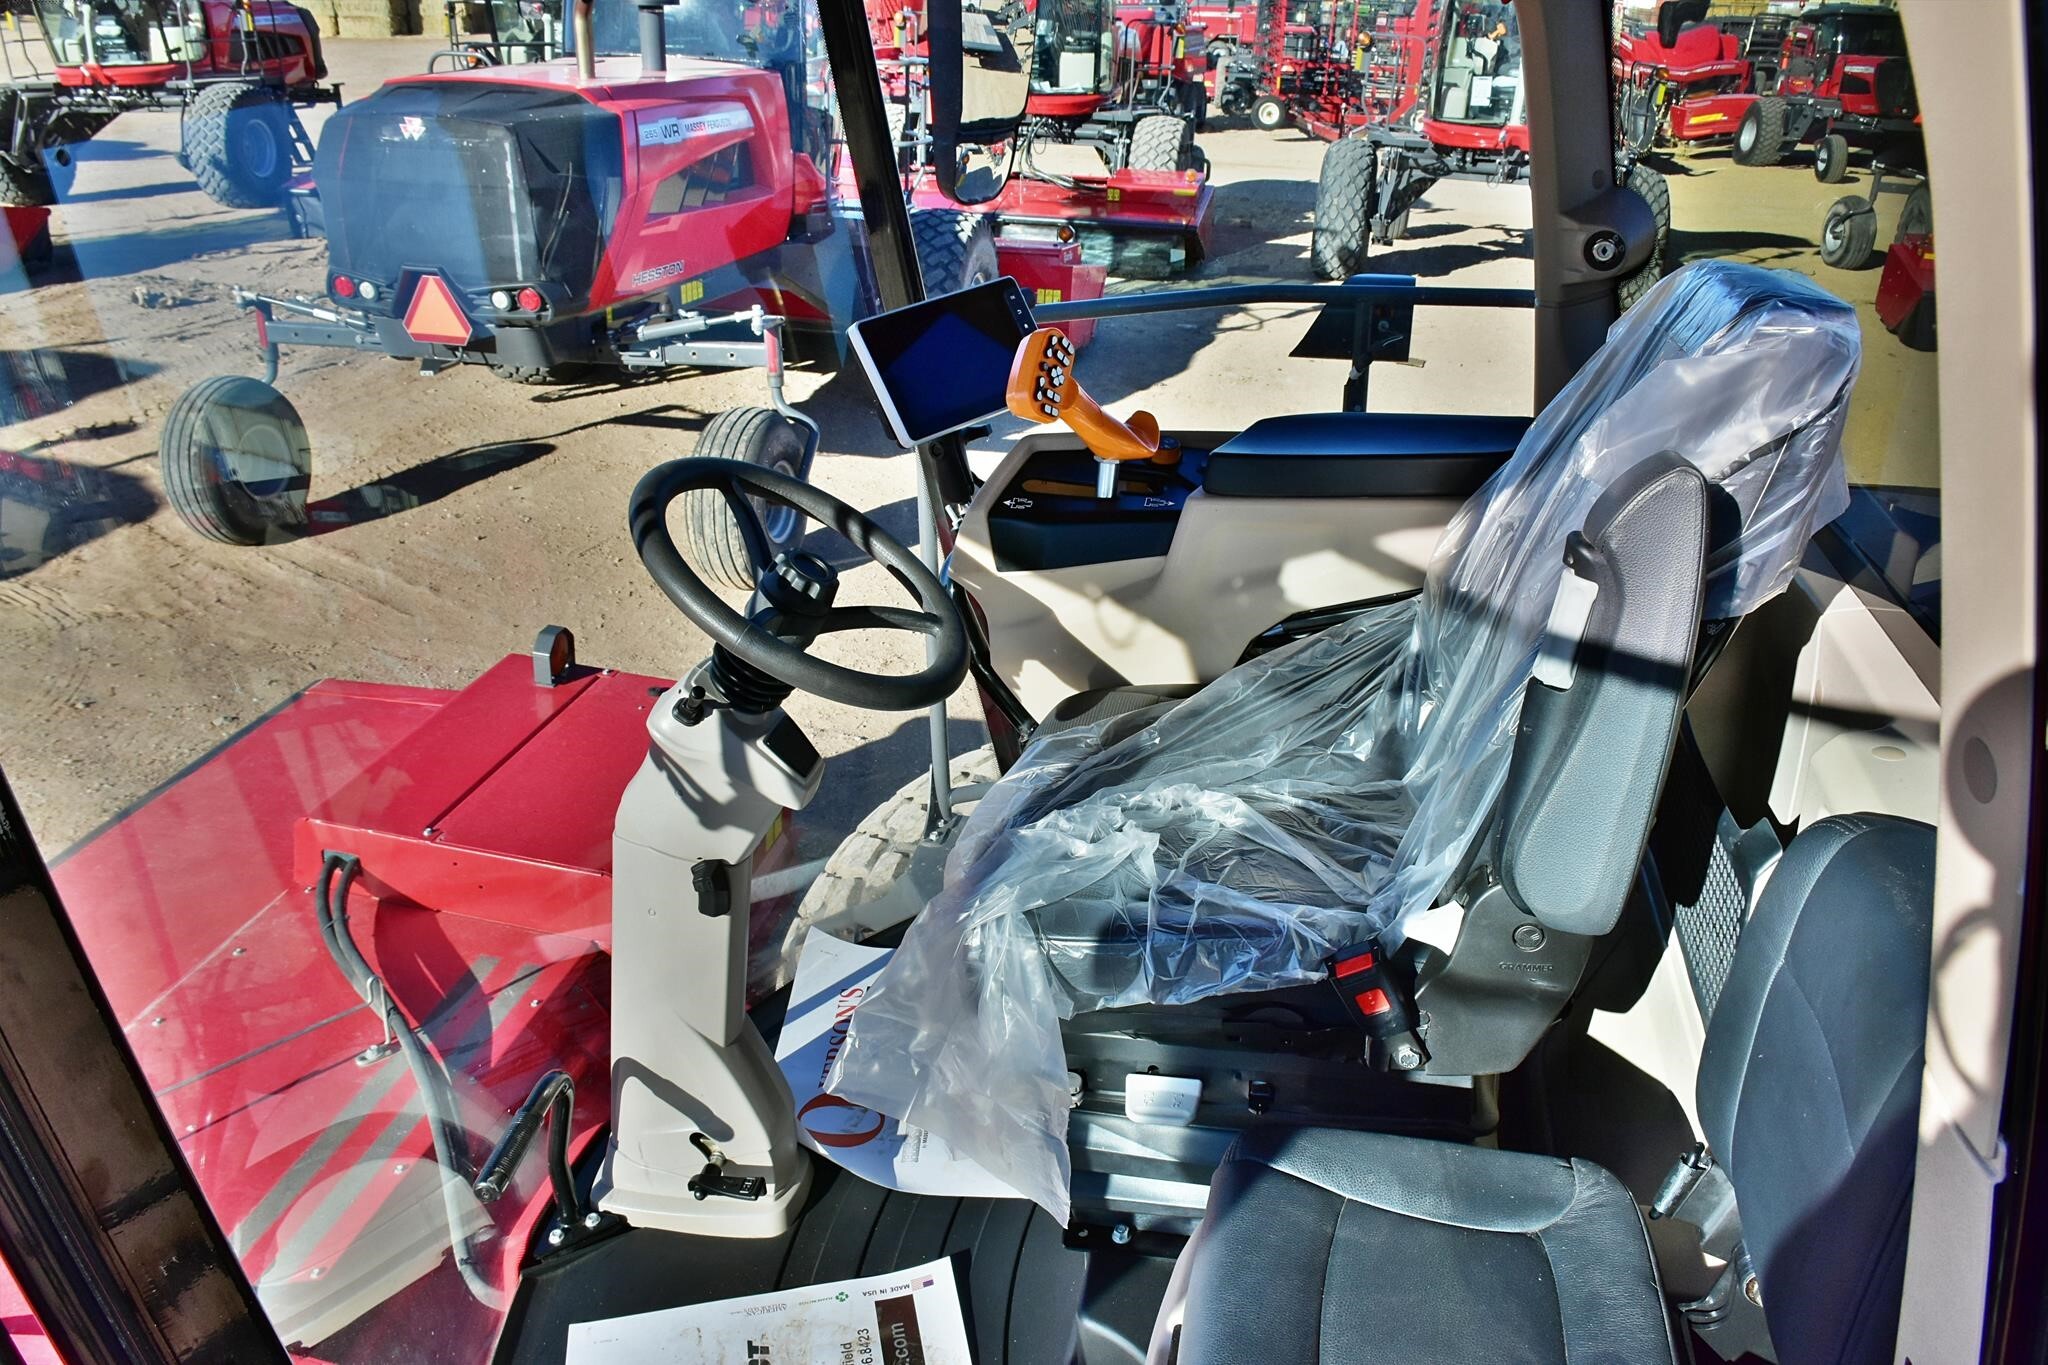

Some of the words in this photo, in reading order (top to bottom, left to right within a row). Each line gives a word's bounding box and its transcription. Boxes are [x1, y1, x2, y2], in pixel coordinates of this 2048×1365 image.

[643, 127, 659, 139] 265
[660, 123, 681, 139] WR
[685, 121, 706, 132] MASSEY
[632, 260, 685, 288] HESSTON
[1499, 961, 1554, 973] GRAMMER
[889, 1283, 911, 1293] MADE
[857, 1328, 873, 1365] 6.8423
[891, 1322, 910, 1365] .com
